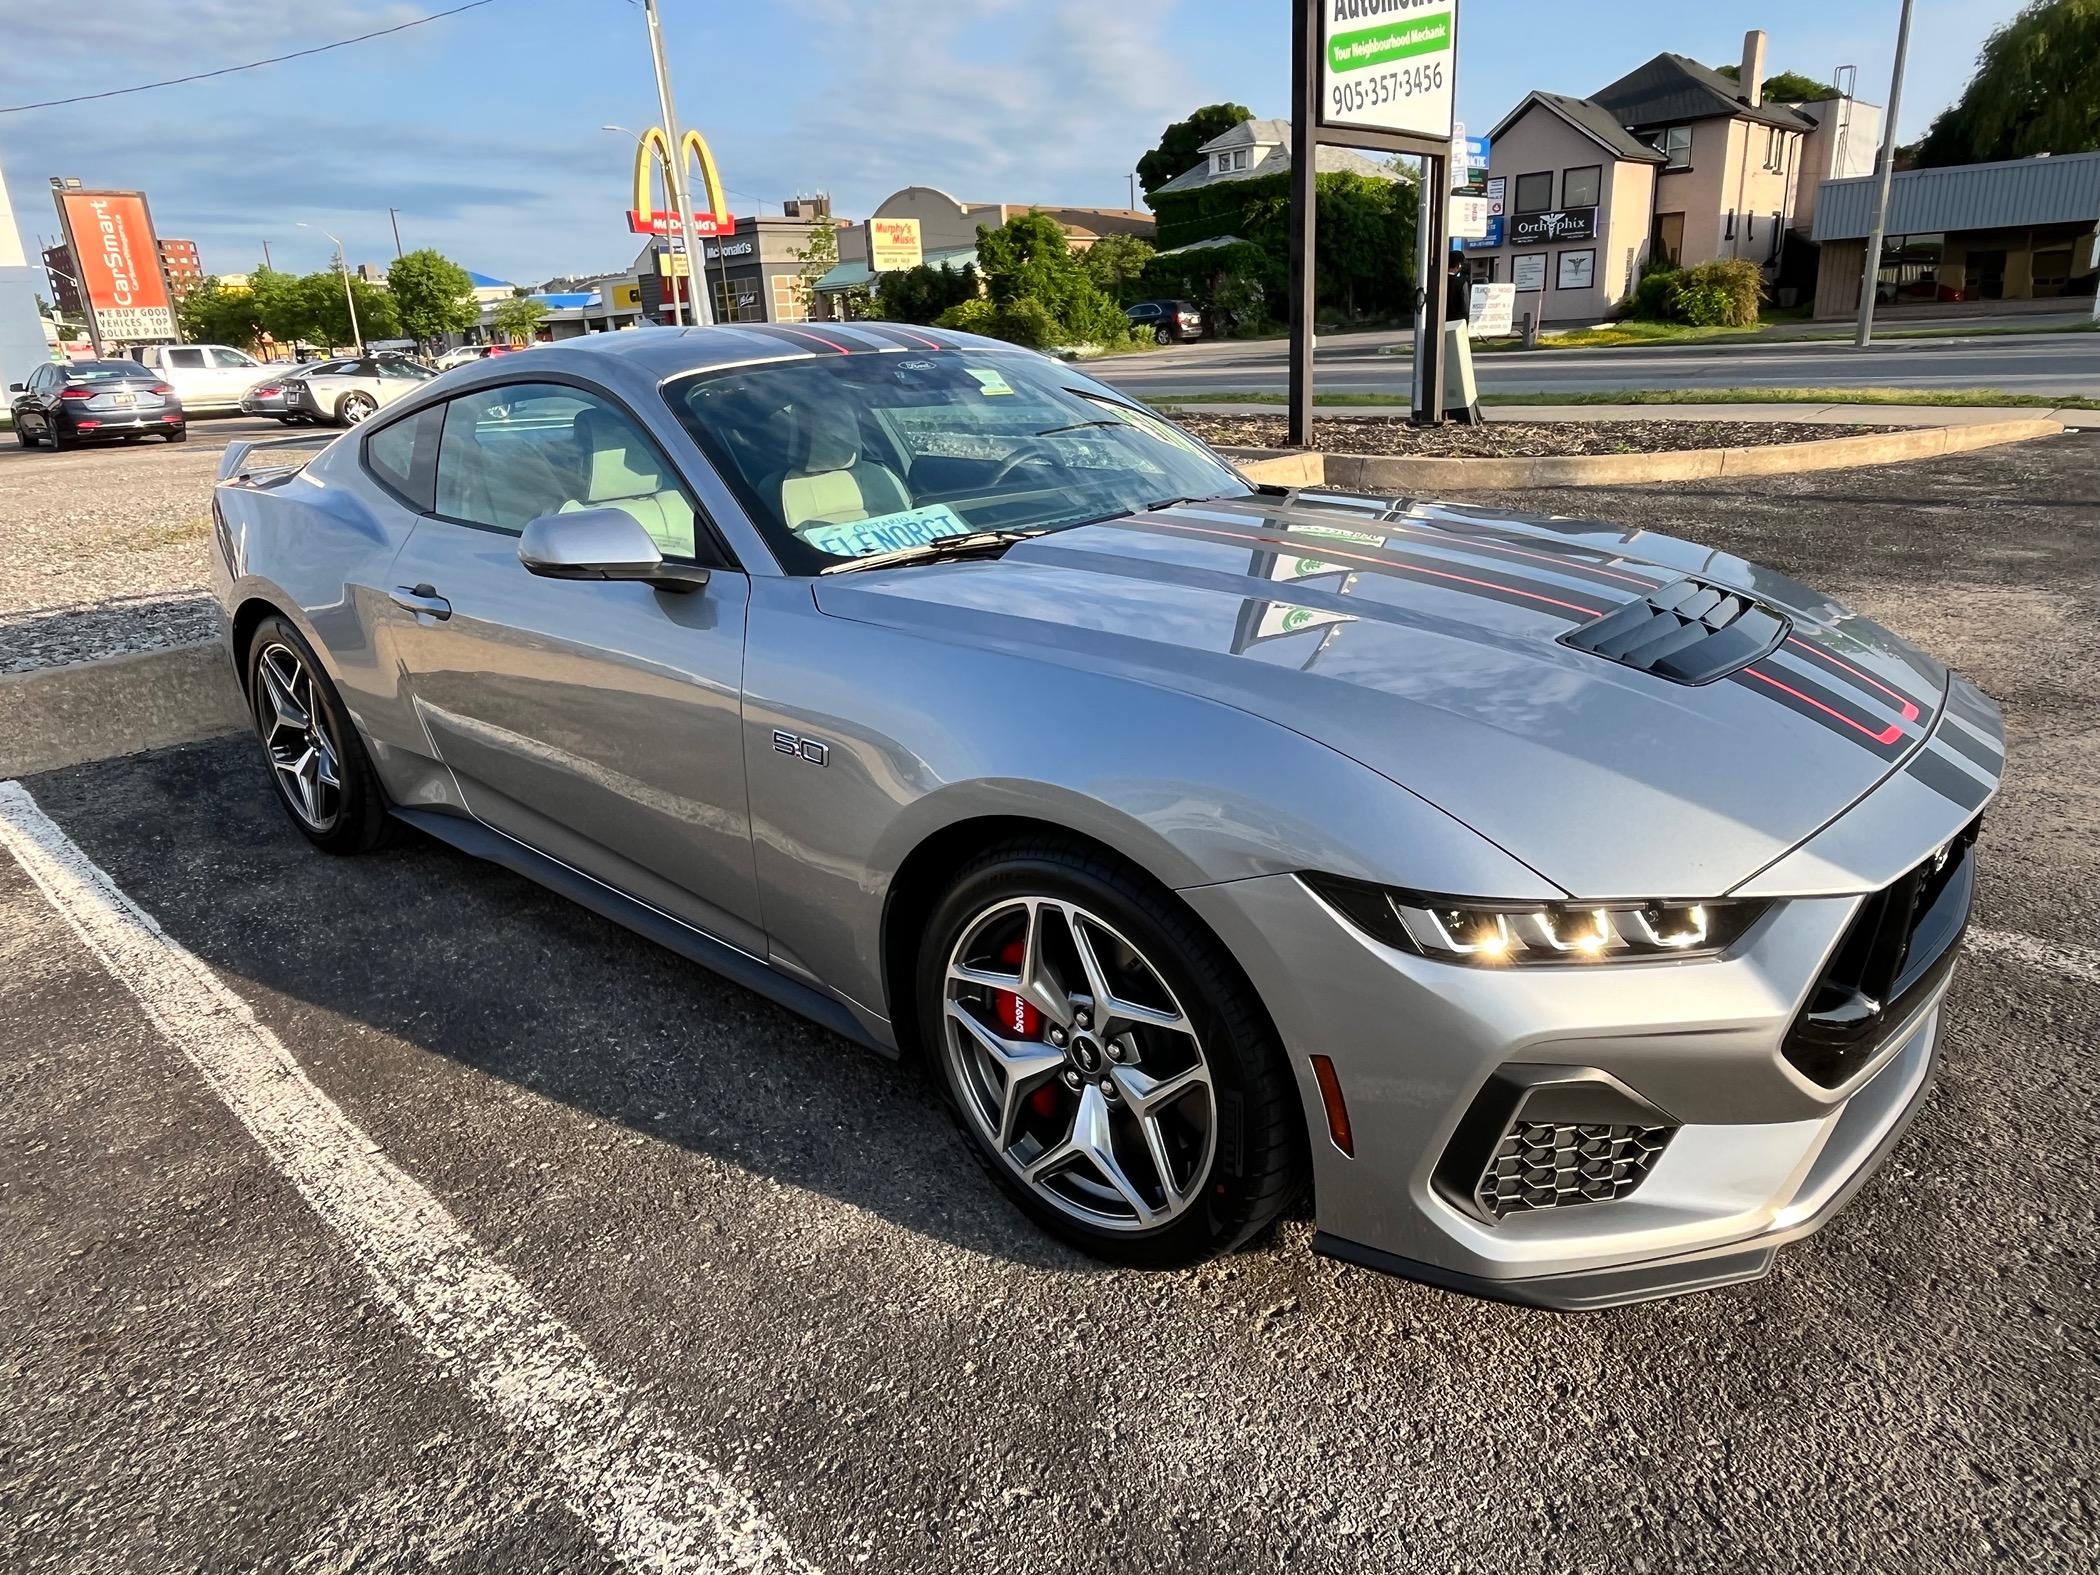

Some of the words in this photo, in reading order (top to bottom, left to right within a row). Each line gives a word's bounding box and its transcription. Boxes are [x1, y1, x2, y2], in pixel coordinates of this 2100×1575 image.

[1334, 46, 1351, 61] Your
[1352, 31, 1410, 59] Neighbourhood
[1411, 24, 1446, 43] Mechanic
[876, 223, 912, 236] Murphy's
[892, 234, 916, 245] Music
[90, 200, 132, 305] CarSmart
[98, 310, 112, 318] WE
[115, 309, 135, 318] BUY
[140, 308, 168, 317] GOOD
[150, 318, 168, 327] TOP
[100, 328, 140, 338] DOLLAR
[853, 516, 910, 533] ONTARIO
[772, 728, 830, 768] 5.0
[1013, 996, 1024, 1034] brem
